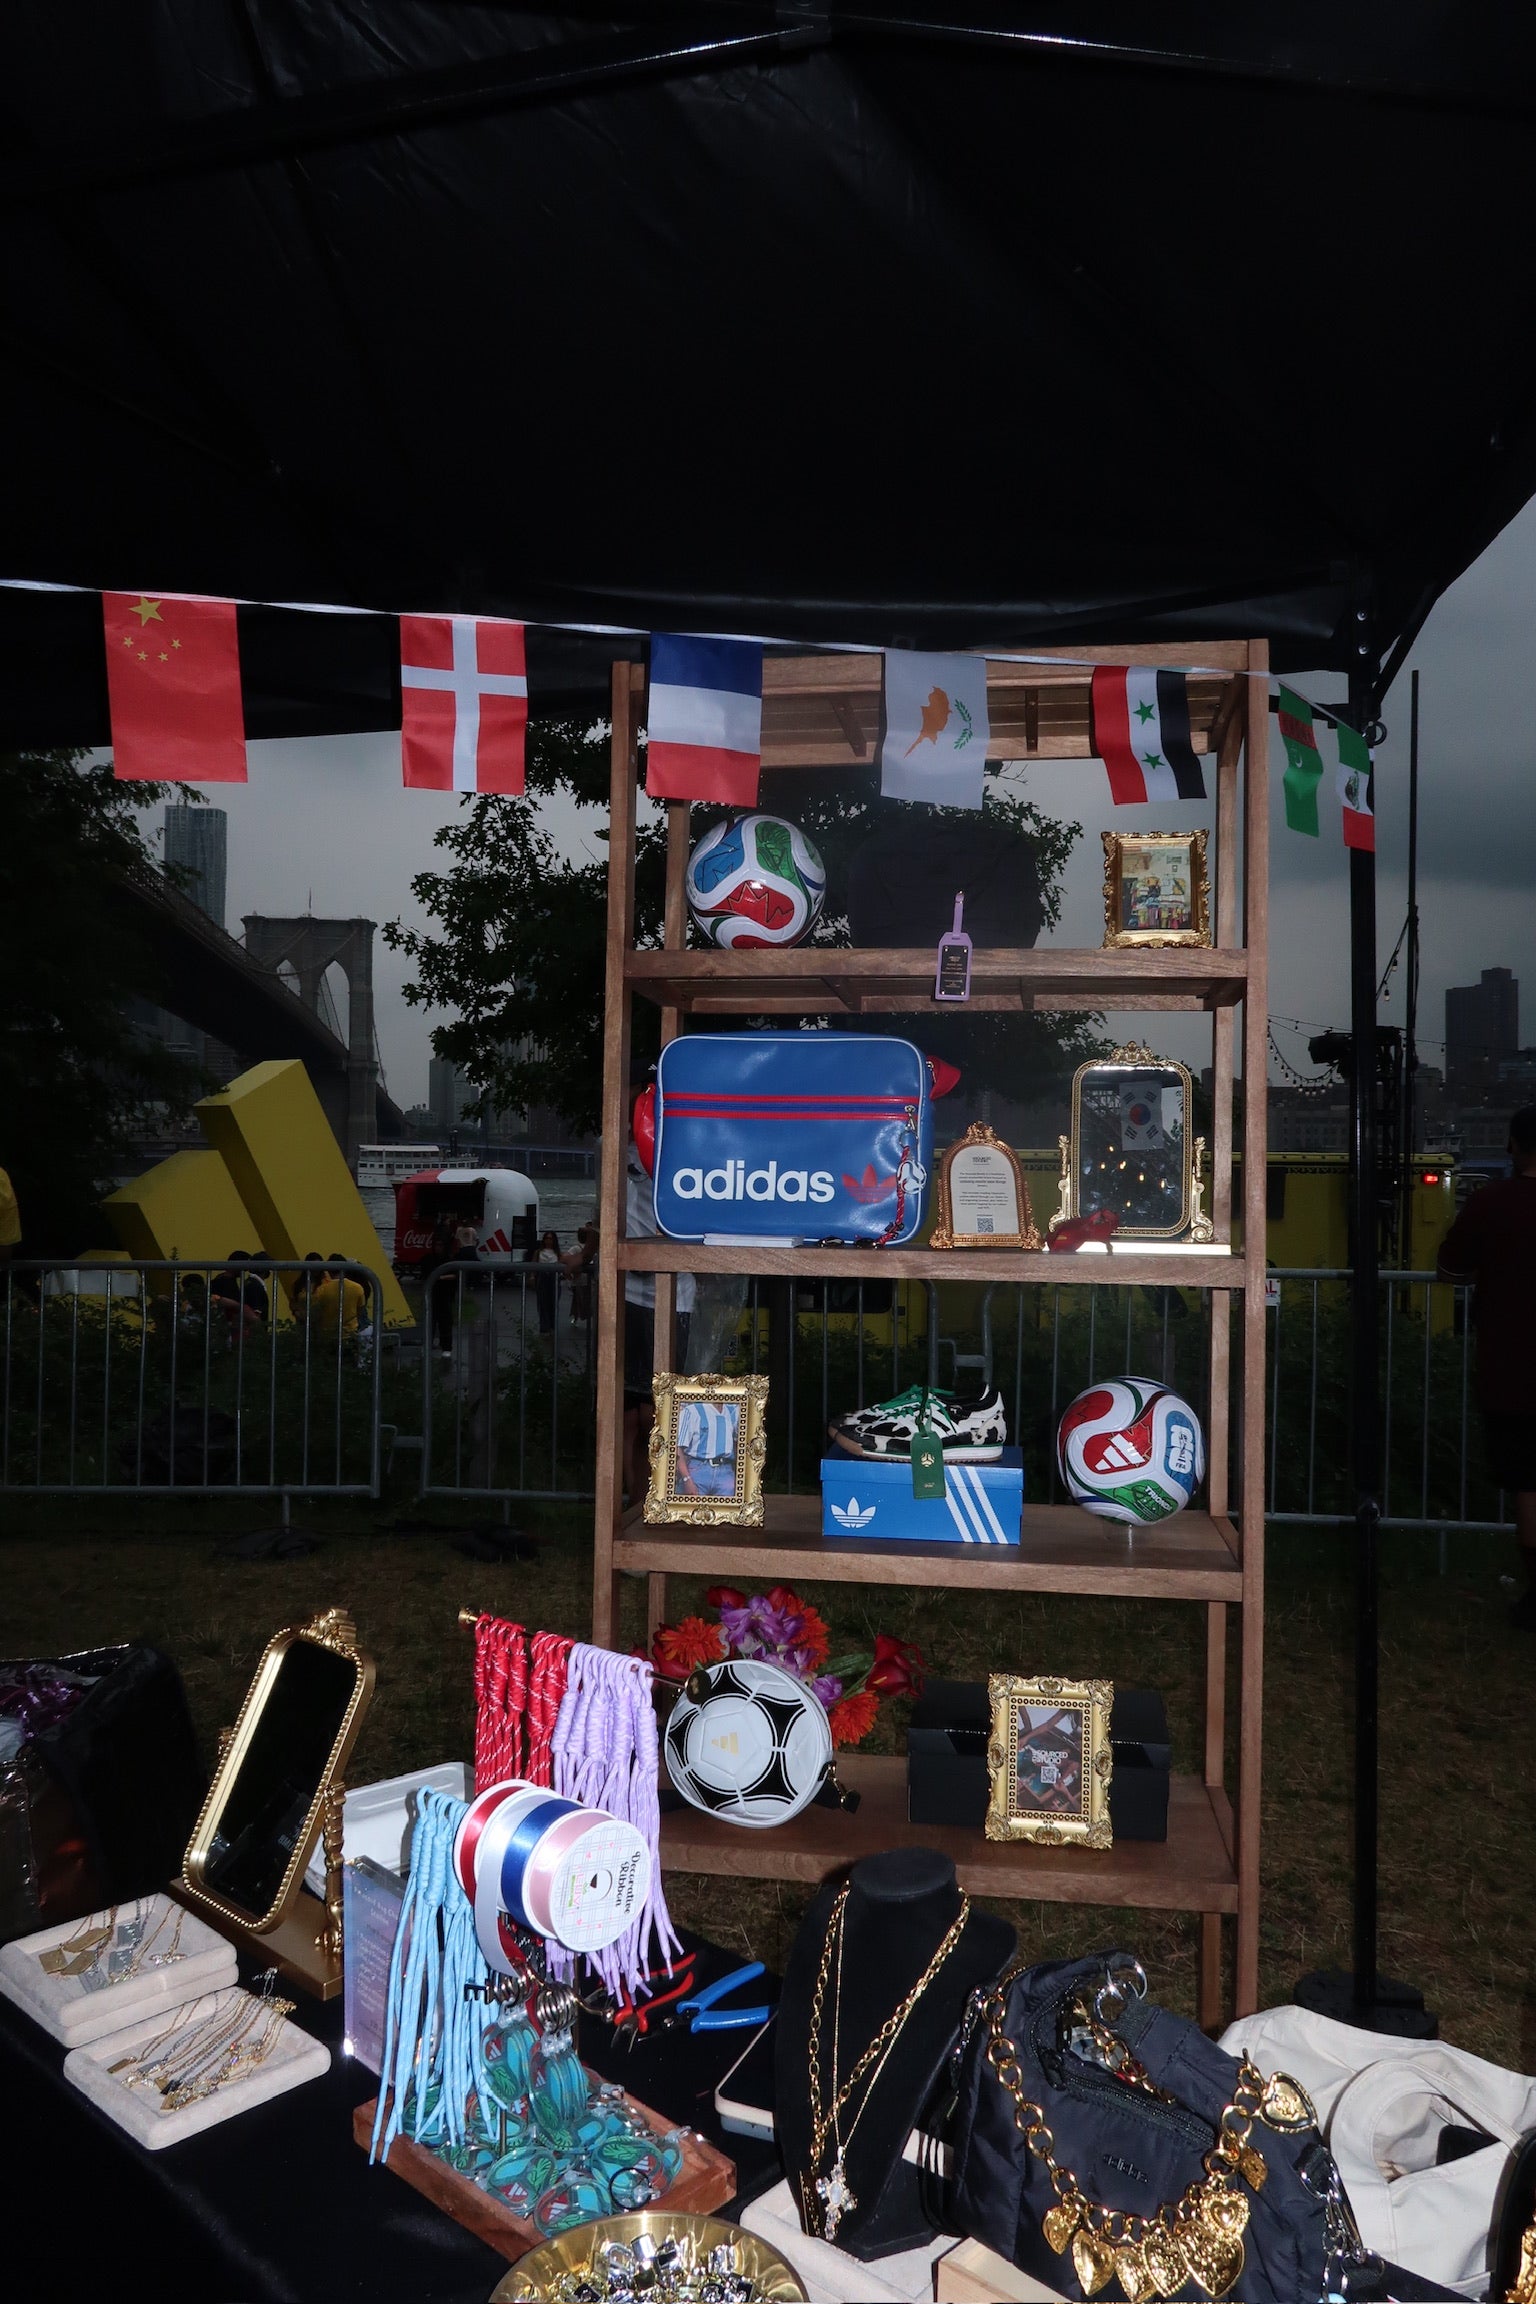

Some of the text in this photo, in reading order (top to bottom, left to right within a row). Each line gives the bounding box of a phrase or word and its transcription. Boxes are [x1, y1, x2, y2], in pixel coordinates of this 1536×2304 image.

[672, 1160, 835, 1203] adidas
[615, 1861, 629, 1907] Ribbon
[625, 1851, 640, 1913] Decorative
